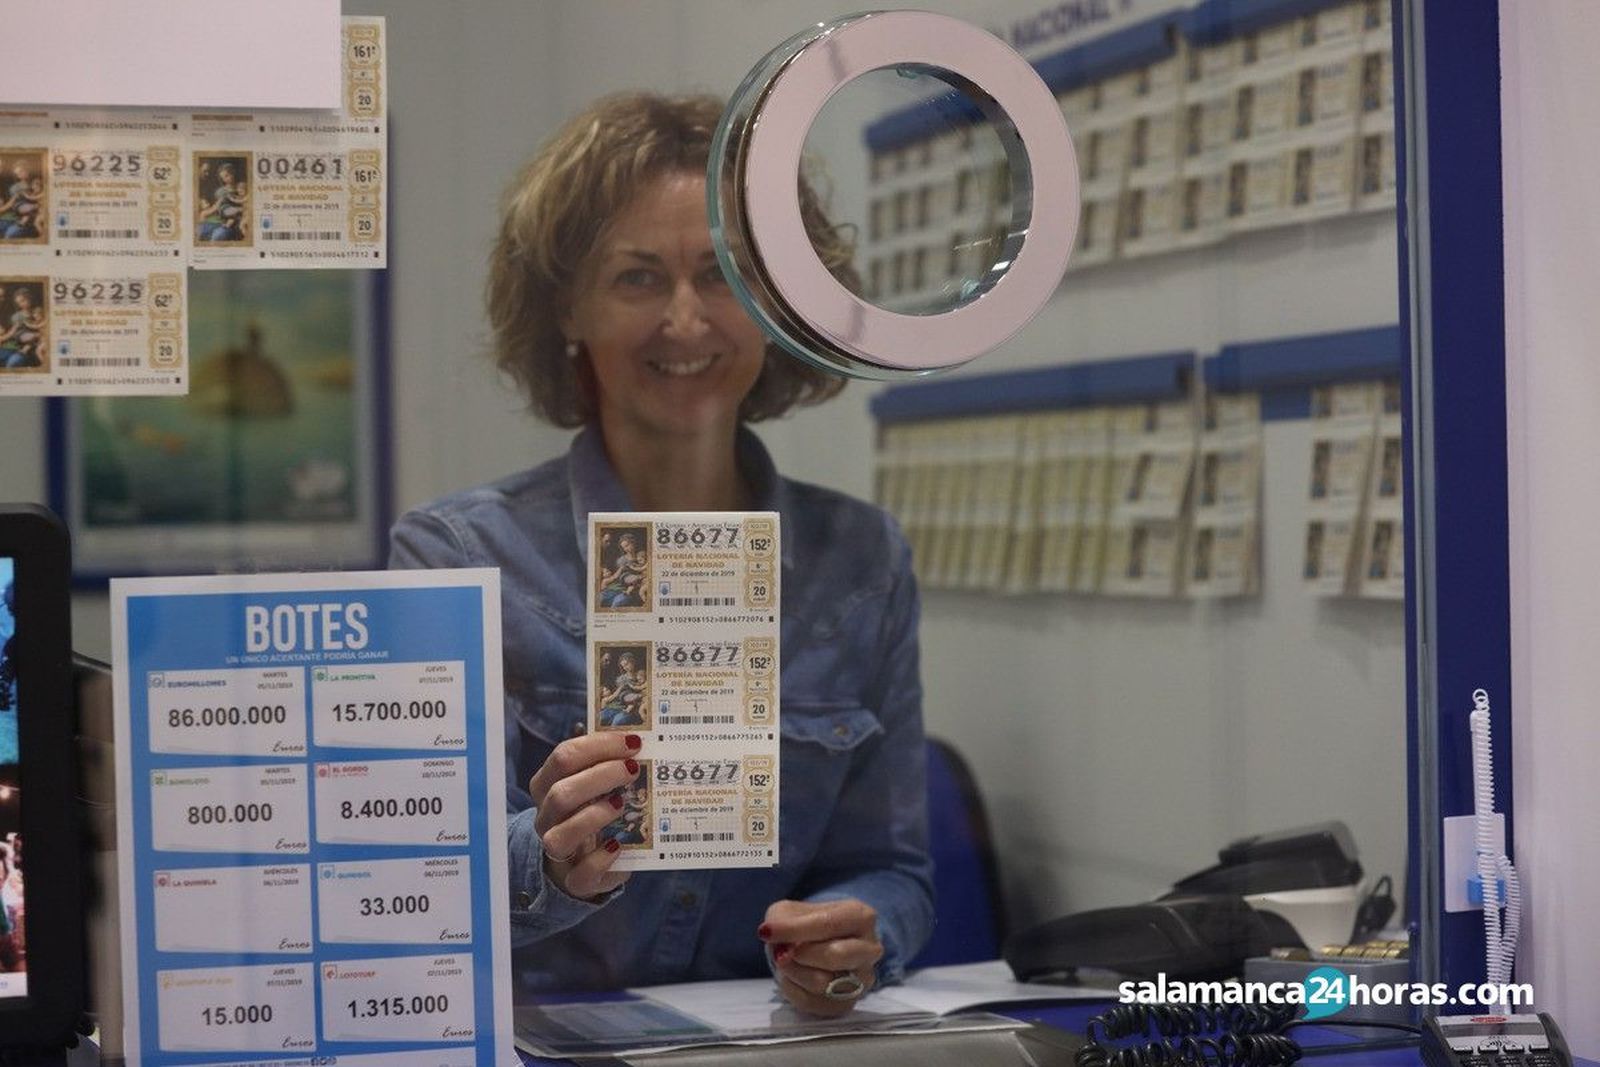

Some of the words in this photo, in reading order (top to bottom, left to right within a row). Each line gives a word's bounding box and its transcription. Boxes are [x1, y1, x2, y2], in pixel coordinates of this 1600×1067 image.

[53, 155, 141, 172] 96225
[257, 158, 342, 175] 00461
[158, 218, 171, 229] 20
[358, 220, 371, 231] 20
[54, 283, 142, 300] 96225
[657, 529, 738, 545] 86677
[754, 586, 766, 596] 20
[245, 602, 369, 653] BOTES
[270, 653, 321, 662] ACERTANTE
[357, 651, 389, 659] GANAR
[657, 647, 738, 662] 86677
[168, 680, 227, 688] EUROMILLONES
[333, 701, 446, 721] 15.700.000
[753, 704, 765, 714] 20
[169, 706, 286, 727] 86.000.000
[434, 734, 464, 746] Euros
[273, 741, 304, 752] Euros
[657, 764, 738, 780] 86677
[657, 789, 692, 797] LOTERÍA
[696, 789, 738, 797] NACIONAL
[188, 803, 272, 824] 800.000
[341, 797, 443, 819] 8.400.000
[752, 821, 765, 831] 20
[436, 830, 468, 842] Euros
[275, 838, 307, 850] Euros
[360, 895, 430, 916] 33.000
[440, 928, 470, 940] Euros
[279, 938, 310, 949] Euros
[348, 995, 448, 1018] 1.315.000
[202, 1004, 272, 1025] 15.000
[442, 1026, 473, 1038] Euros
[282, 1036, 313, 1048] Euros
